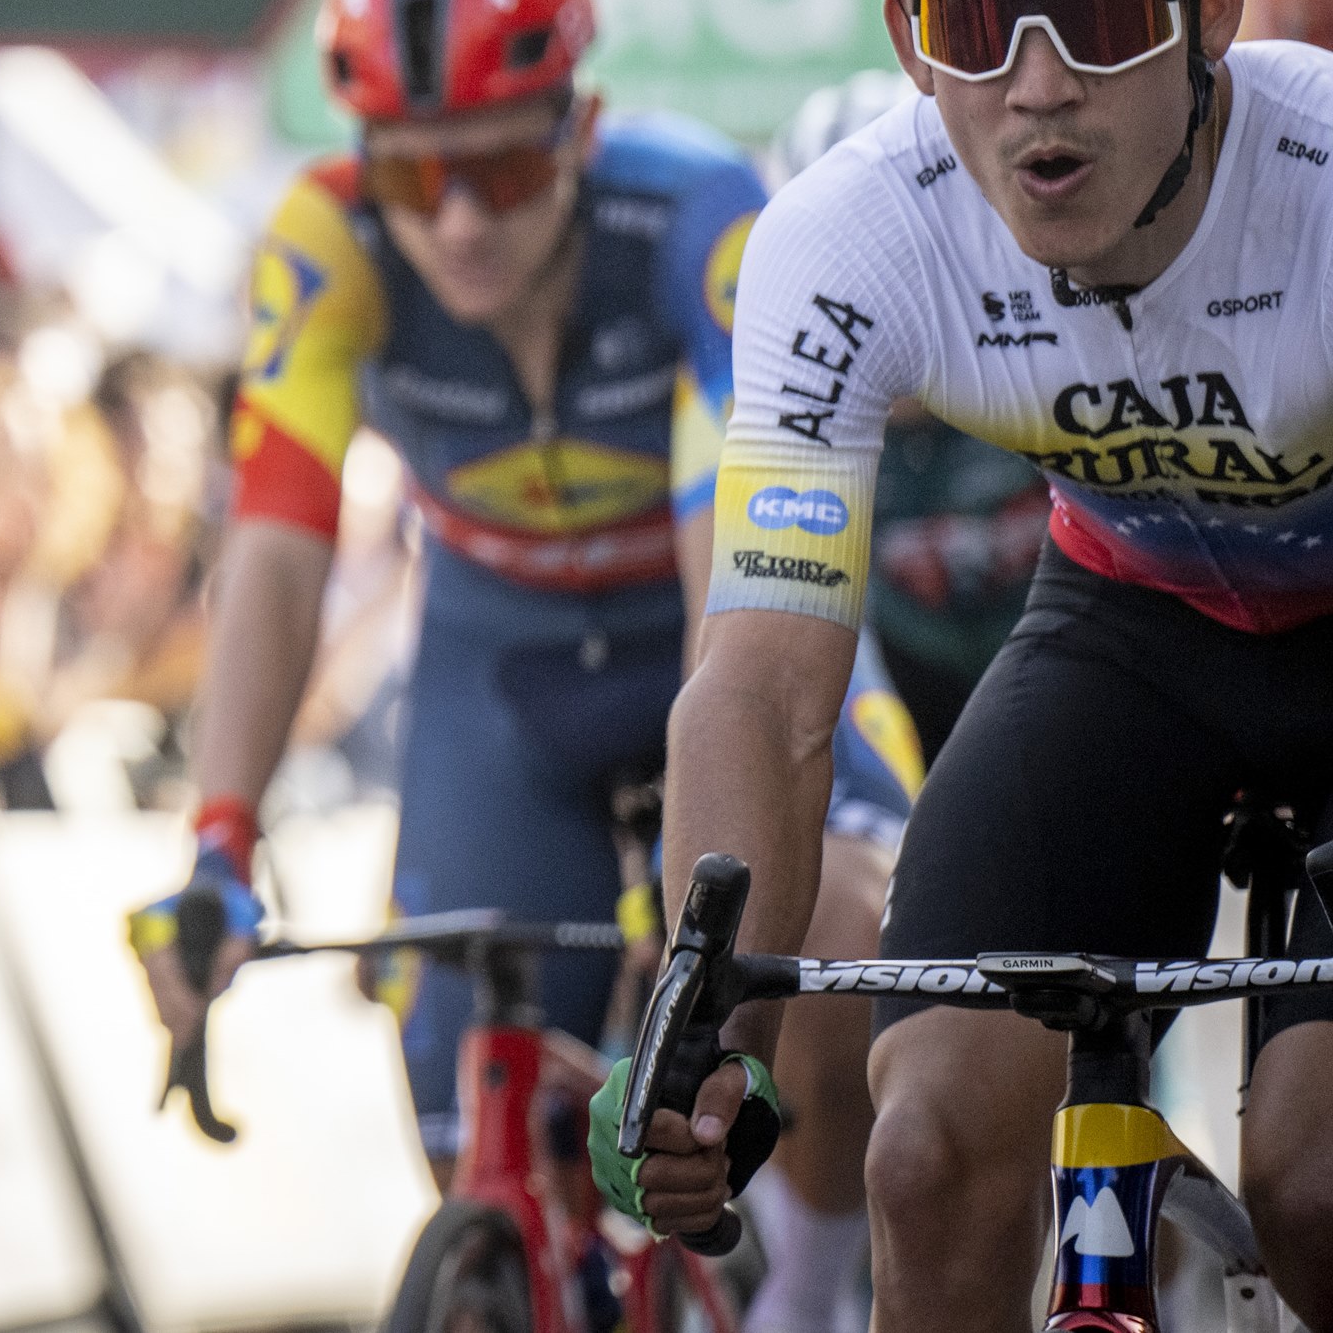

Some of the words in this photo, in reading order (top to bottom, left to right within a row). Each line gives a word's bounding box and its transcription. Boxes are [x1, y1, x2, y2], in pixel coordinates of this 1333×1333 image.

[915, 154, 959, 190] ED4U
[1206, 291, 1285, 318] GSPORT
[777, 293, 876, 449] ALEA
[1053, 371, 1256, 439] CAJA
[754, 497, 843, 524] KMC
[1002, 959, 1054, 969] GARMIN
